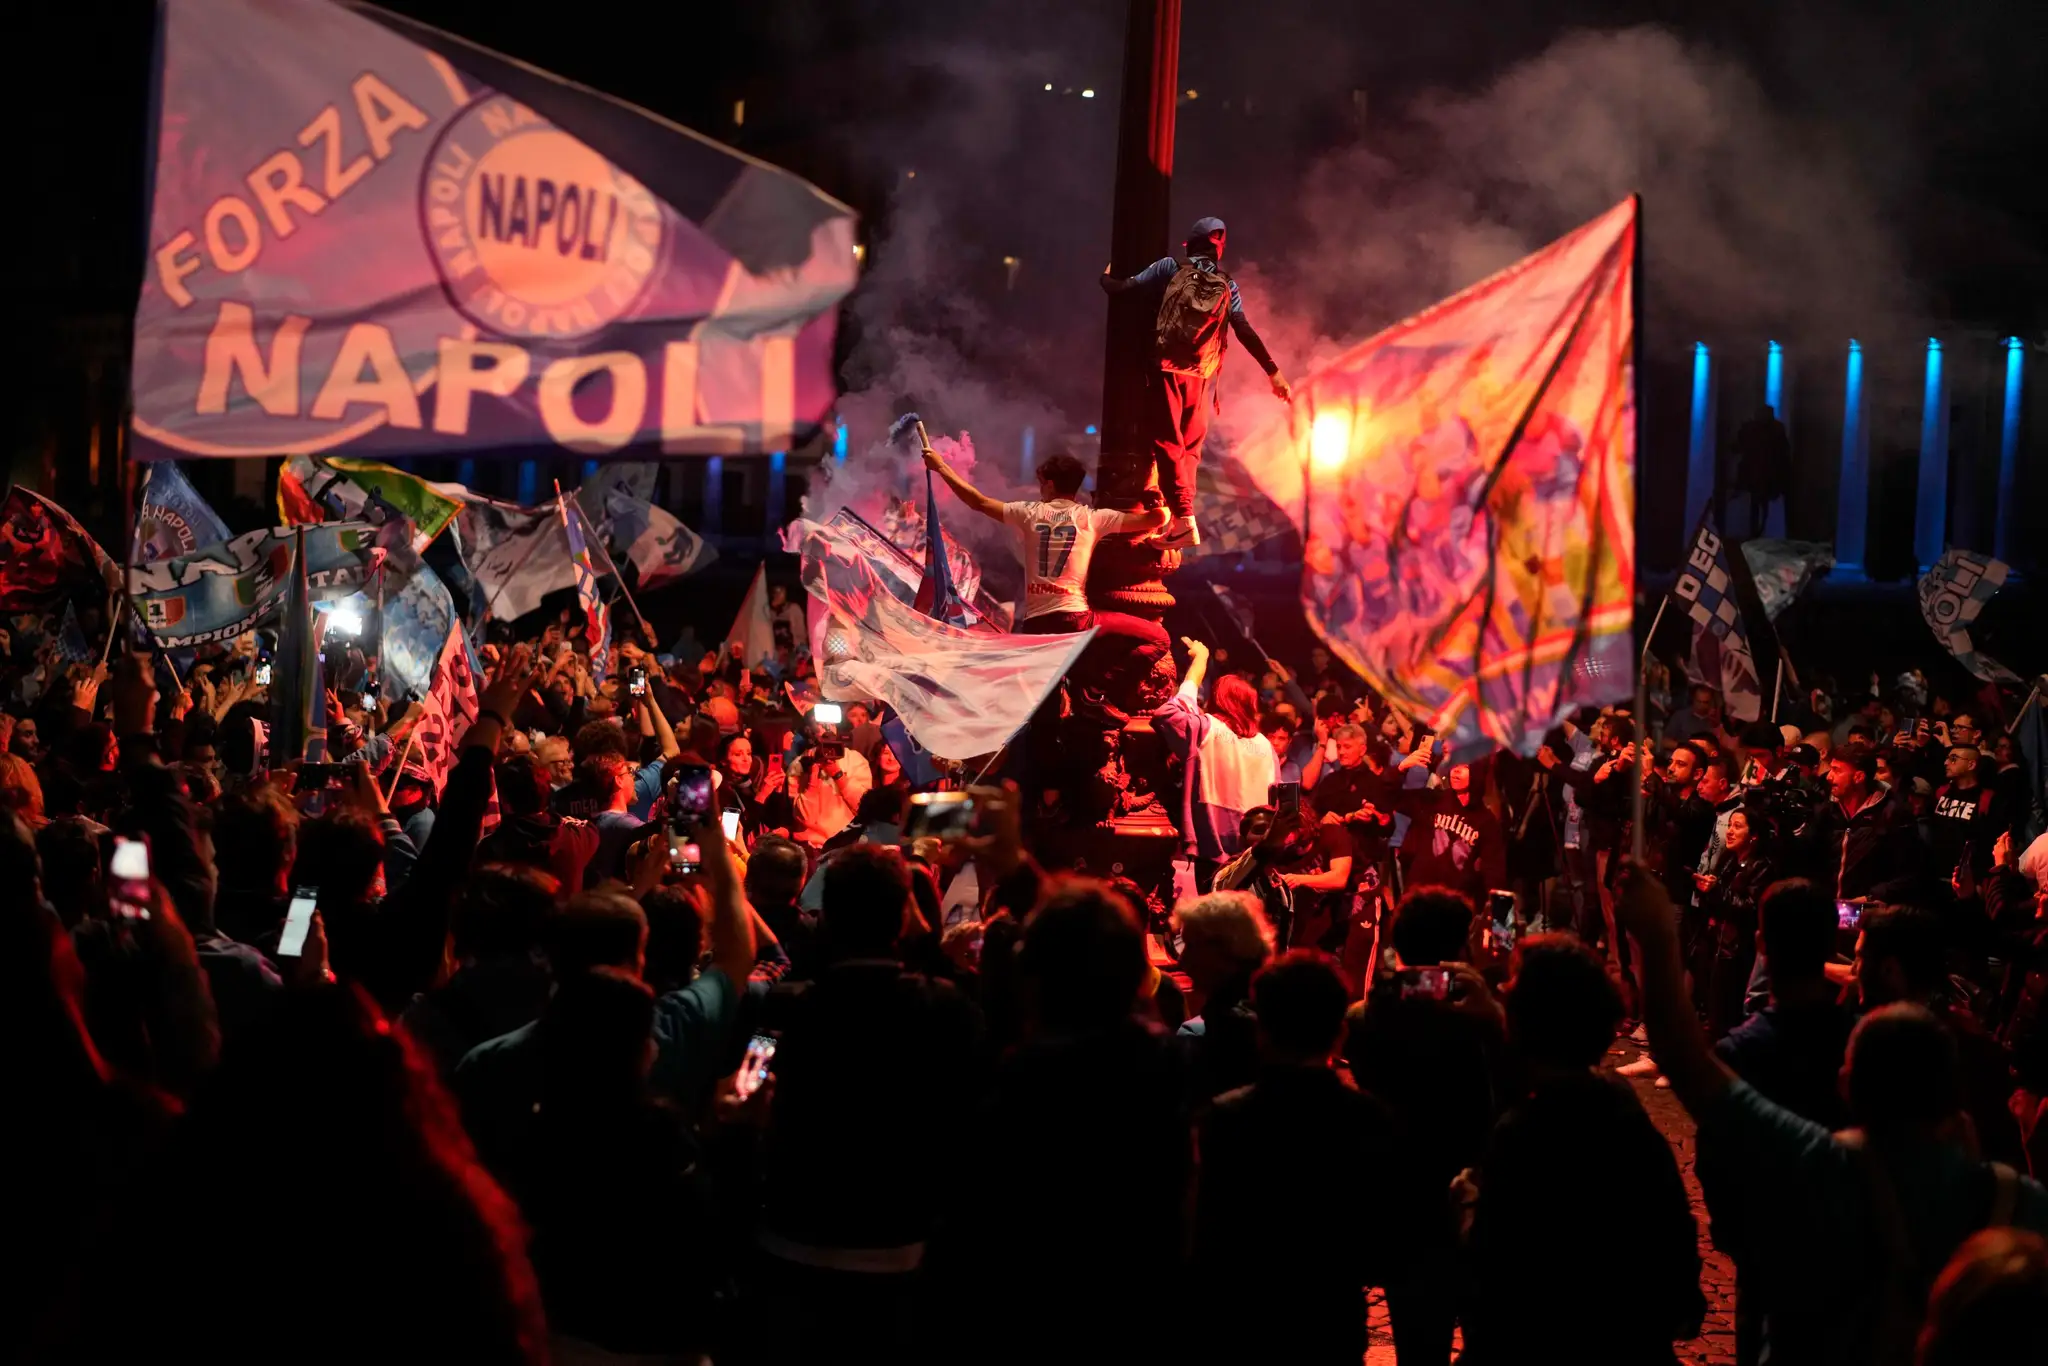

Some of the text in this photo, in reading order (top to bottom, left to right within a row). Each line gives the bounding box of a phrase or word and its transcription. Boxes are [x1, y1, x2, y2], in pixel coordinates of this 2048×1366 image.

[153, 71, 430, 309] FORZA
[479, 172, 618, 265] NAPOLI
[196, 301, 796, 456] NAPOLI
[1035, 525, 1077, 578] 17
[1932, 556, 1988, 628] OLI
[149, 603, 164, 616] 1
